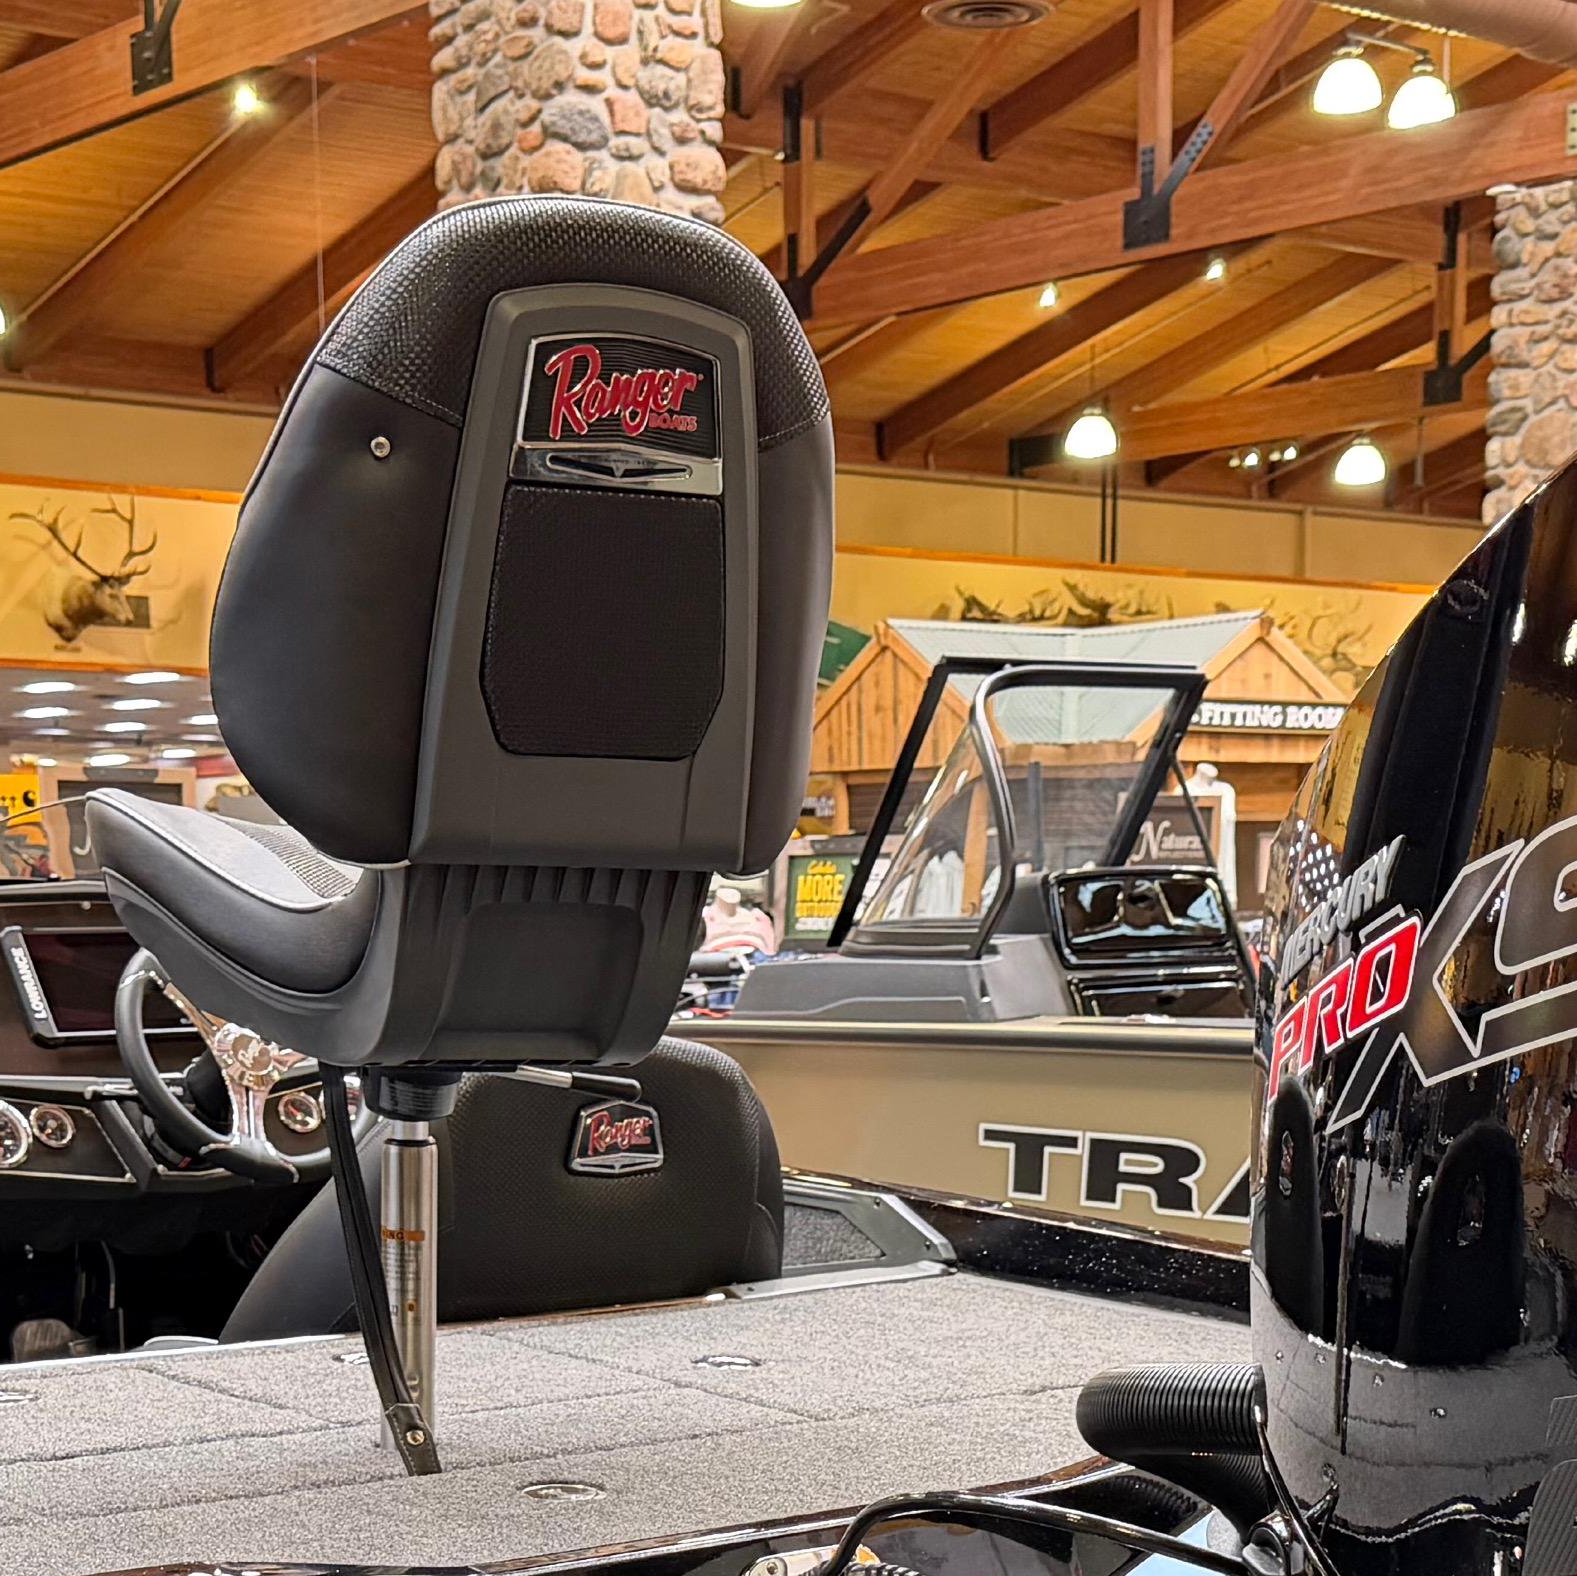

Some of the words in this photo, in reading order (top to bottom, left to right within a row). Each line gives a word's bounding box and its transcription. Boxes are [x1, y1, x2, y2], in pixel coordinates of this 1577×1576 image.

[544, 344, 698, 440] Ranger
[648, 412, 698, 432] BOATS
[1200, 702, 1284, 727] FITTING
[797, 873, 846, 902] MORE
[1281, 834, 1407, 991] MERCURY
[10, 947, 47, 1018] LOWRANCE
[1266, 914, 1422, 1107] PRO
